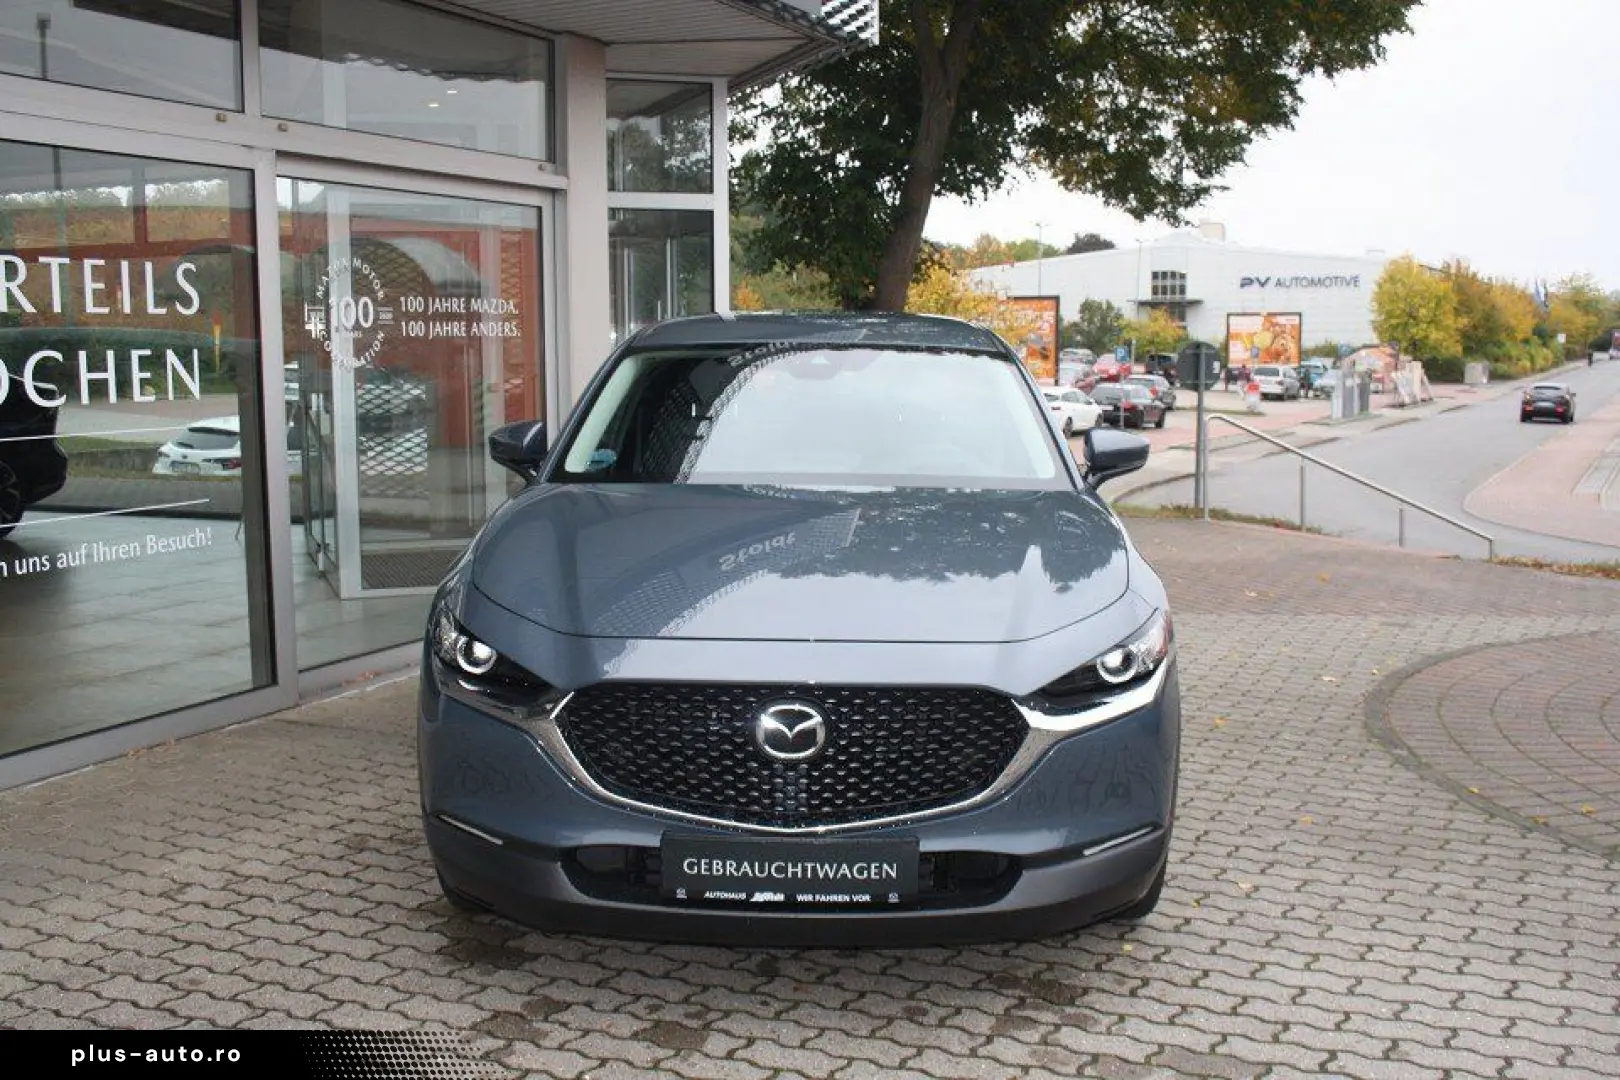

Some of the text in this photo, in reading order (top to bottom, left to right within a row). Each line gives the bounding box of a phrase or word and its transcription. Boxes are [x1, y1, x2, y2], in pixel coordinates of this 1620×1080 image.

[0, 254, 200, 315] RTEILS
[352, 257, 385, 300] MOTOR
[1240, 275, 1360, 289] PV AUTOMOTIVE
[329, 296, 374, 328] 100
[400, 296, 519, 315] 100 JAHRE MAZDA.
[401, 321, 521, 339] 100 JAHRE ANDERS.
[0, 348, 200, 407] CHEN
[14, 554, 50, 575] uns
[56, 542, 88, 569] auf
[92, 540, 141, 563] Ihren
[146, 526, 212, 555] Besuch!
[683, 858, 898, 880] GEBRAUCHTWAGEN
[703, 890, 747, 900] AUTOHAUS
[796, 893, 871, 902] WIR FAHREN VOR
